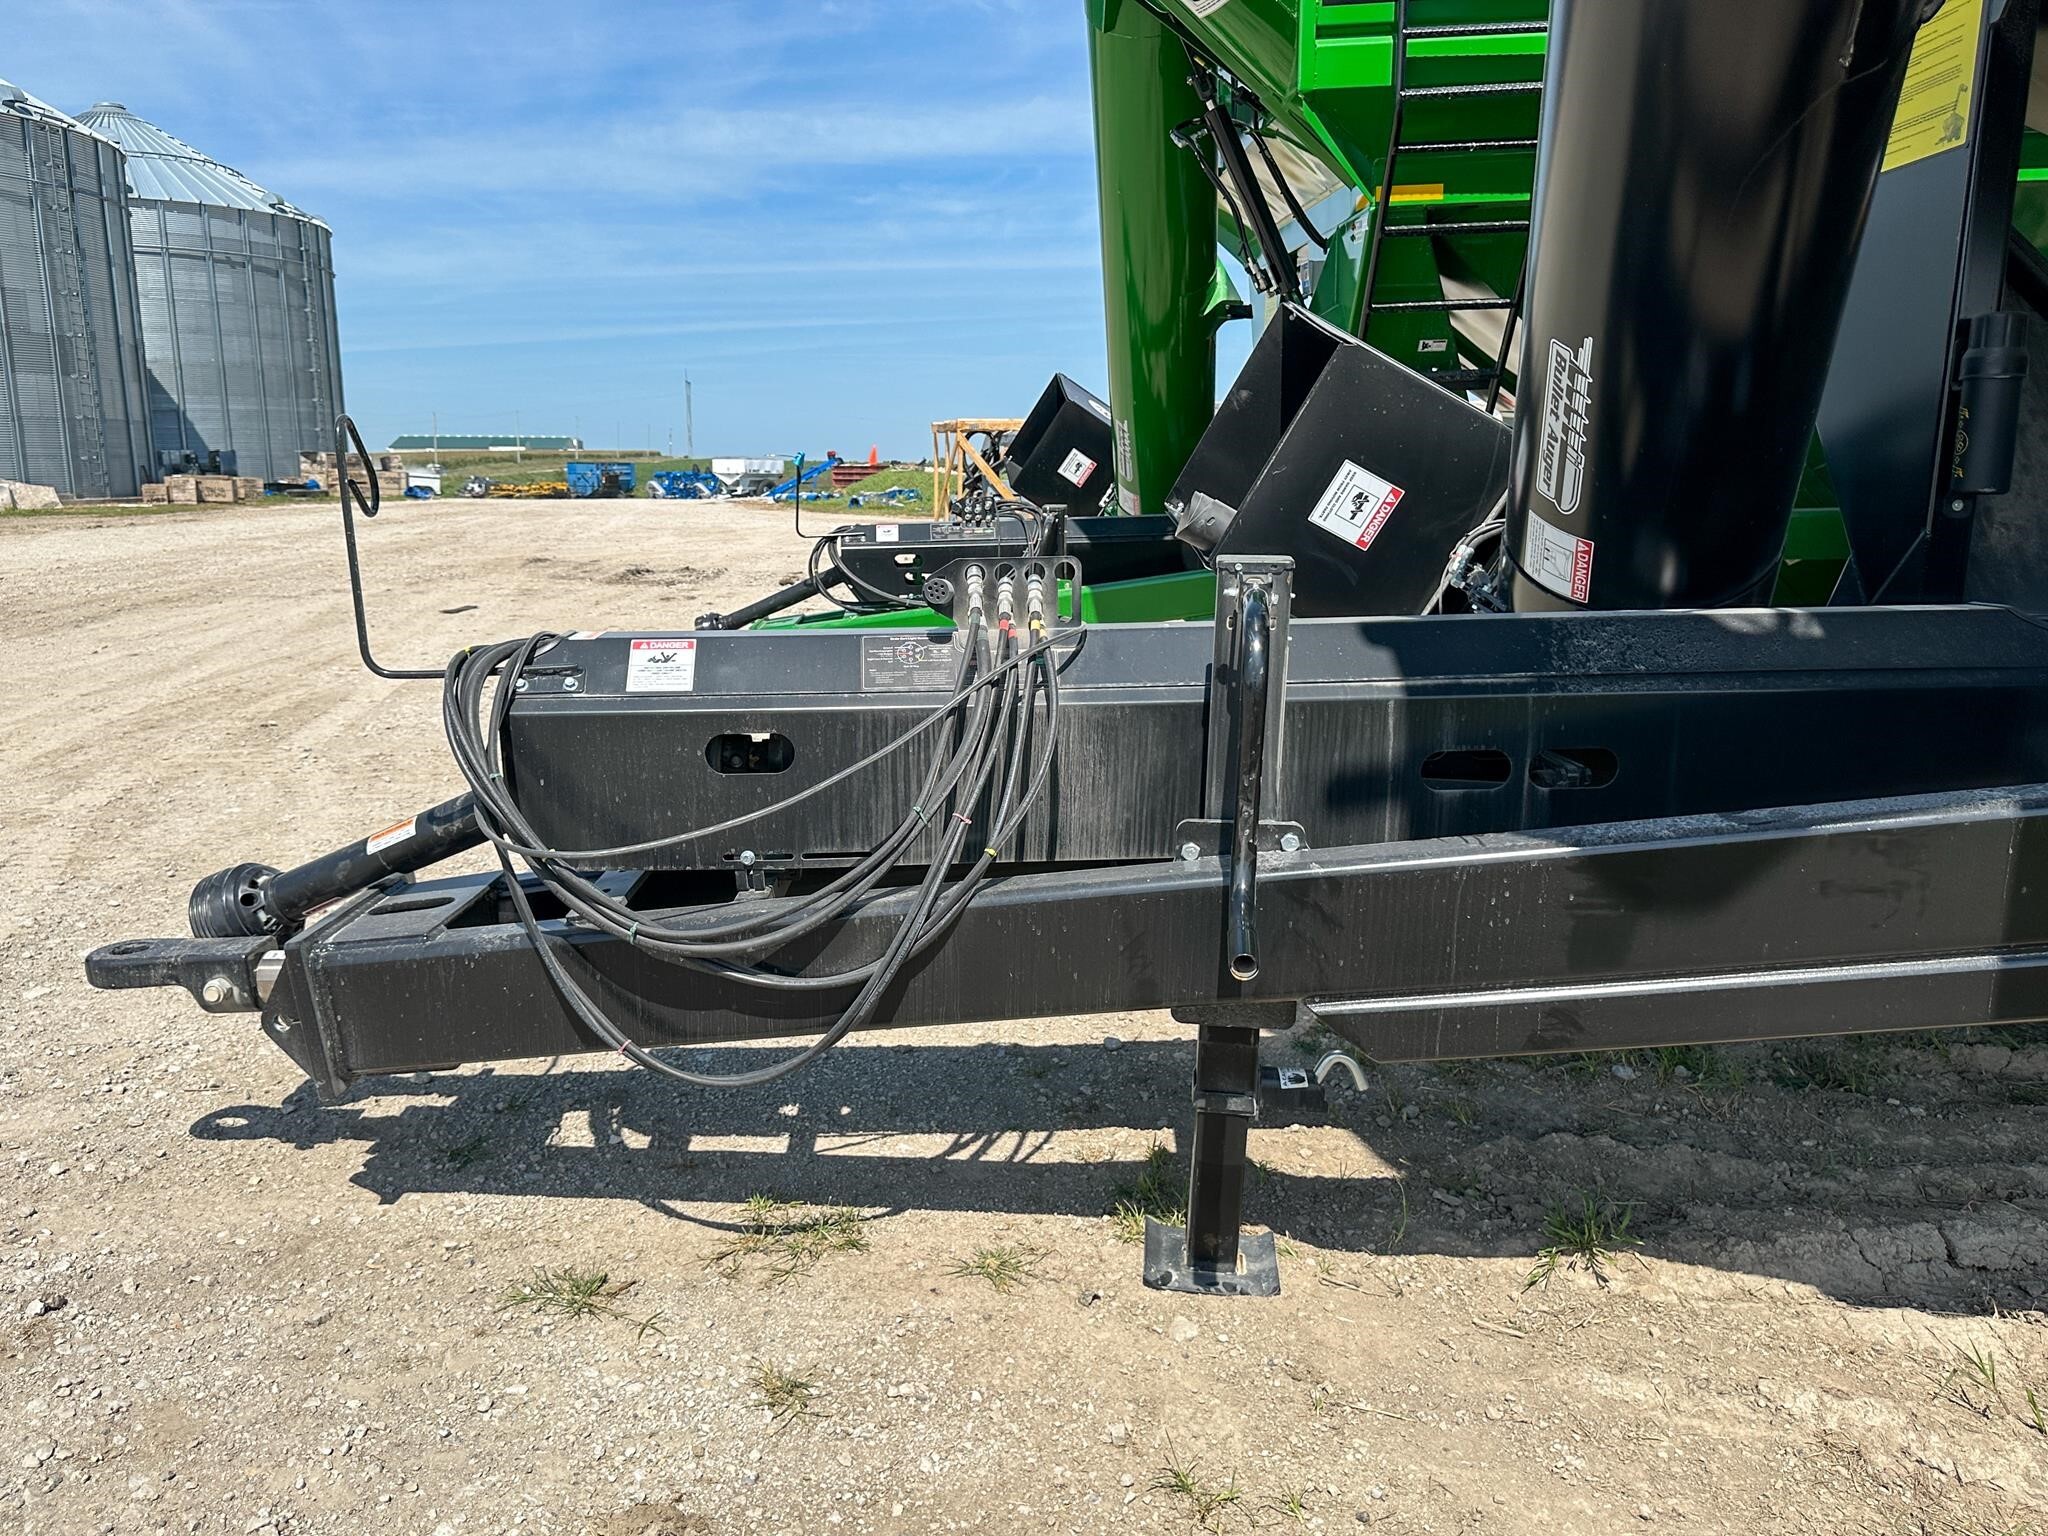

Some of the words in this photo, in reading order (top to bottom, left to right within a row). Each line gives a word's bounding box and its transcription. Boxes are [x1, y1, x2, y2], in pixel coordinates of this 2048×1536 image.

[1549, 349, 1567, 421] Bullet
[1542, 423, 1559, 491] Auger
[1359, 502, 1391, 543] DANGER
[1573, 552, 1588, 599] DANGER
